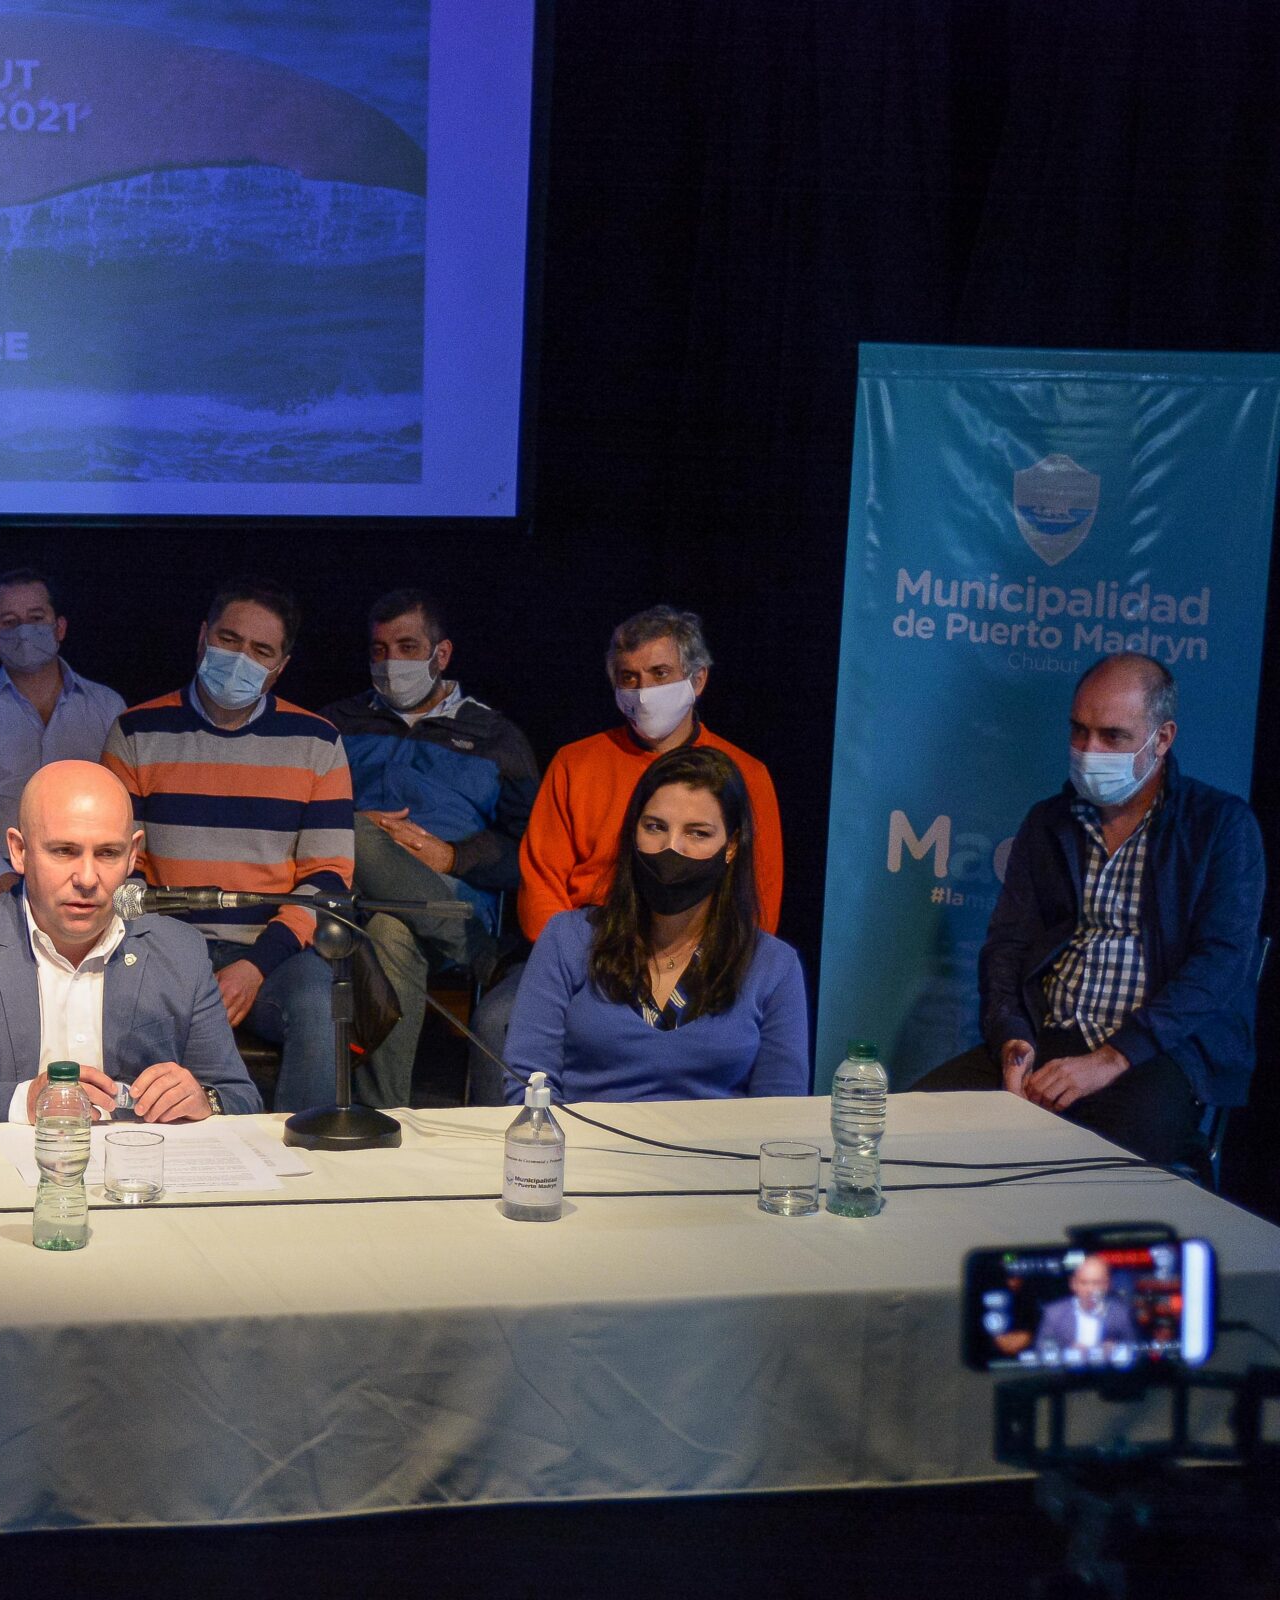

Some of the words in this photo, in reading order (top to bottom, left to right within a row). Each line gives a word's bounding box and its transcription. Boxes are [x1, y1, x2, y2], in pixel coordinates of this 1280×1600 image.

[895, 568, 1211, 625] Municipalidad
[893, 608, 936, 639] de
[946, 613, 1063, 649] Puerto
[1074, 622, 1208, 664] Madryn
[1007, 652, 1081, 673] Chubut
